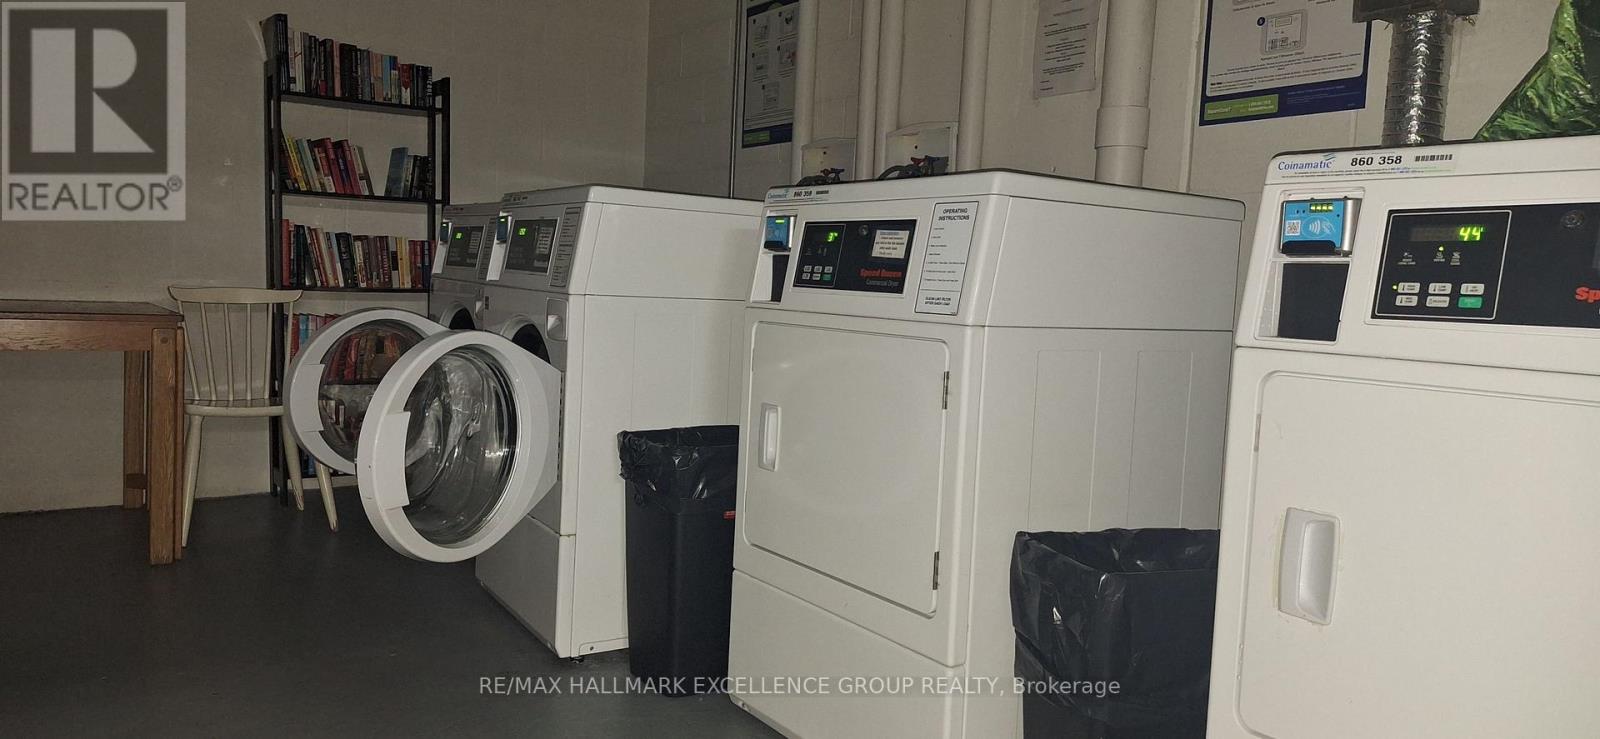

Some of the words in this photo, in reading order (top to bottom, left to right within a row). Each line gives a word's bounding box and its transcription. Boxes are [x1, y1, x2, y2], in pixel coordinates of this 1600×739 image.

[1278, 160, 1332, 171] Coinamatic
[1351, 156, 1374, 166] 860
[1378, 155, 1402, 165] 358
